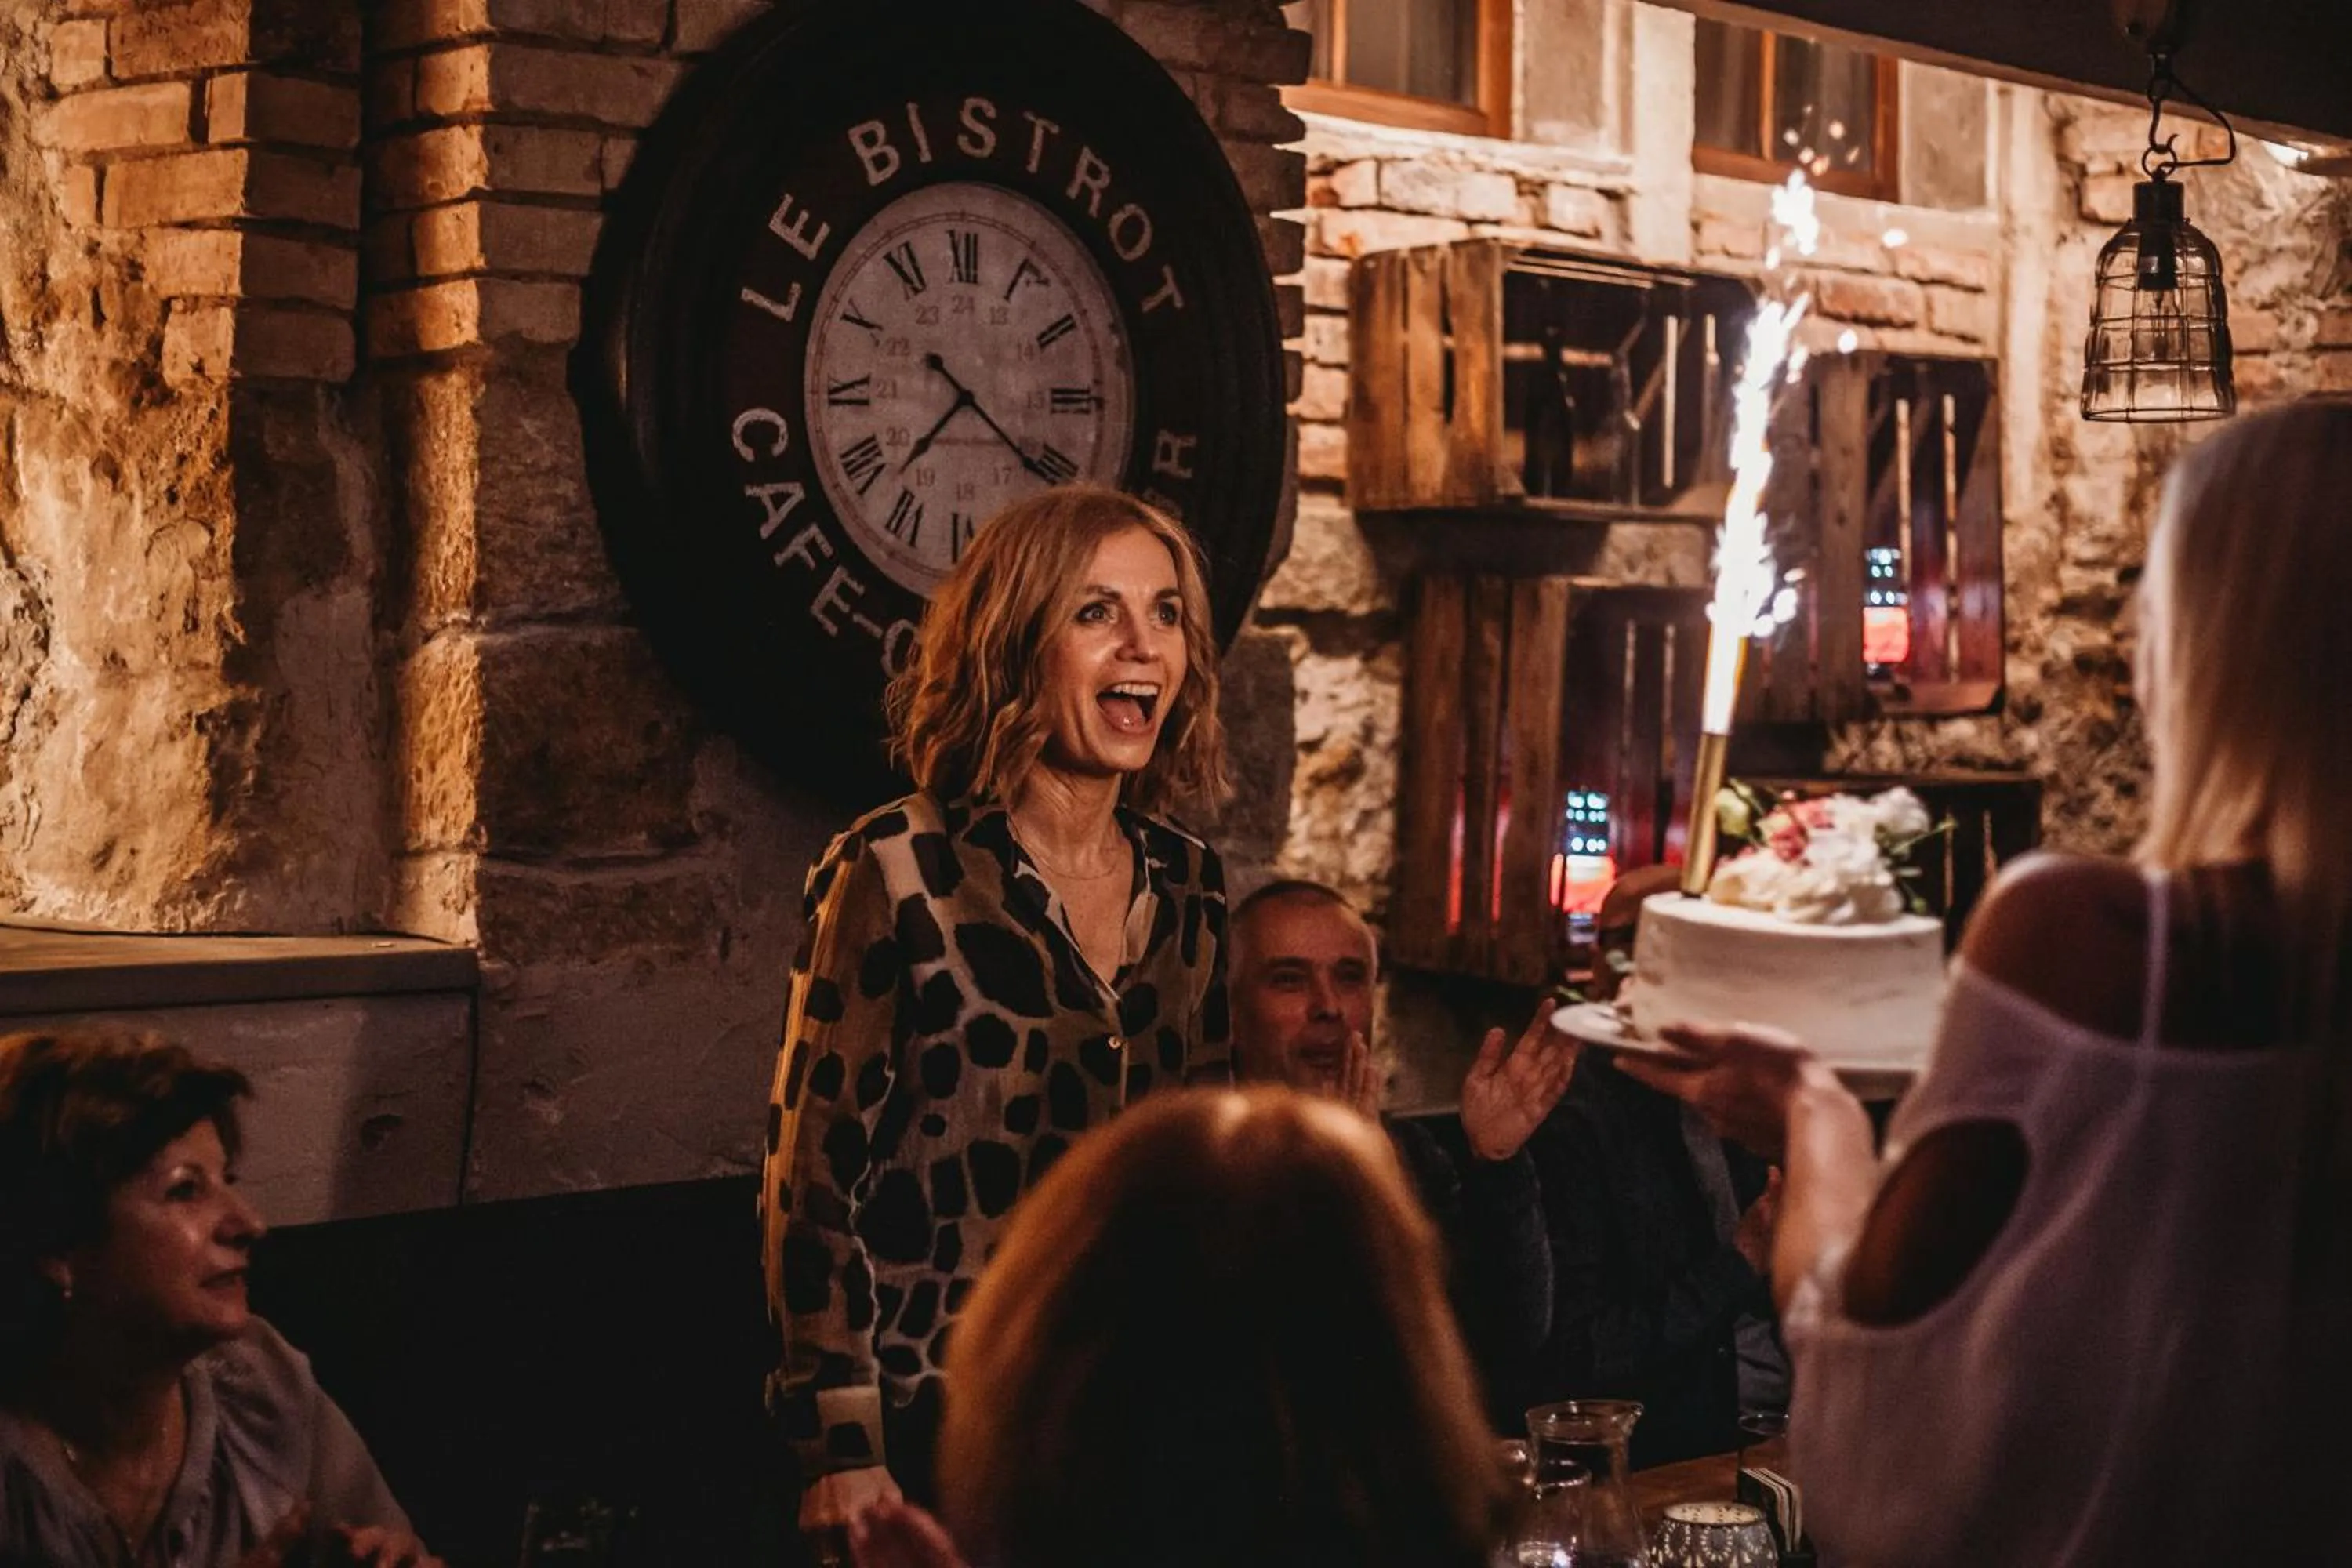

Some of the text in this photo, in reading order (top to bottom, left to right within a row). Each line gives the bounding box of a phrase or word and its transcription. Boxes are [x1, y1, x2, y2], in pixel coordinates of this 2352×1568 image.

[741, 96, 1185, 322] LE BISTROT
[883, 241, 927, 301] XI
[946, 229, 978, 284] XII
[1036, 314, 1076, 347] II
[1051, 387, 1091, 414] III
[840, 434, 887, 495] VIII
